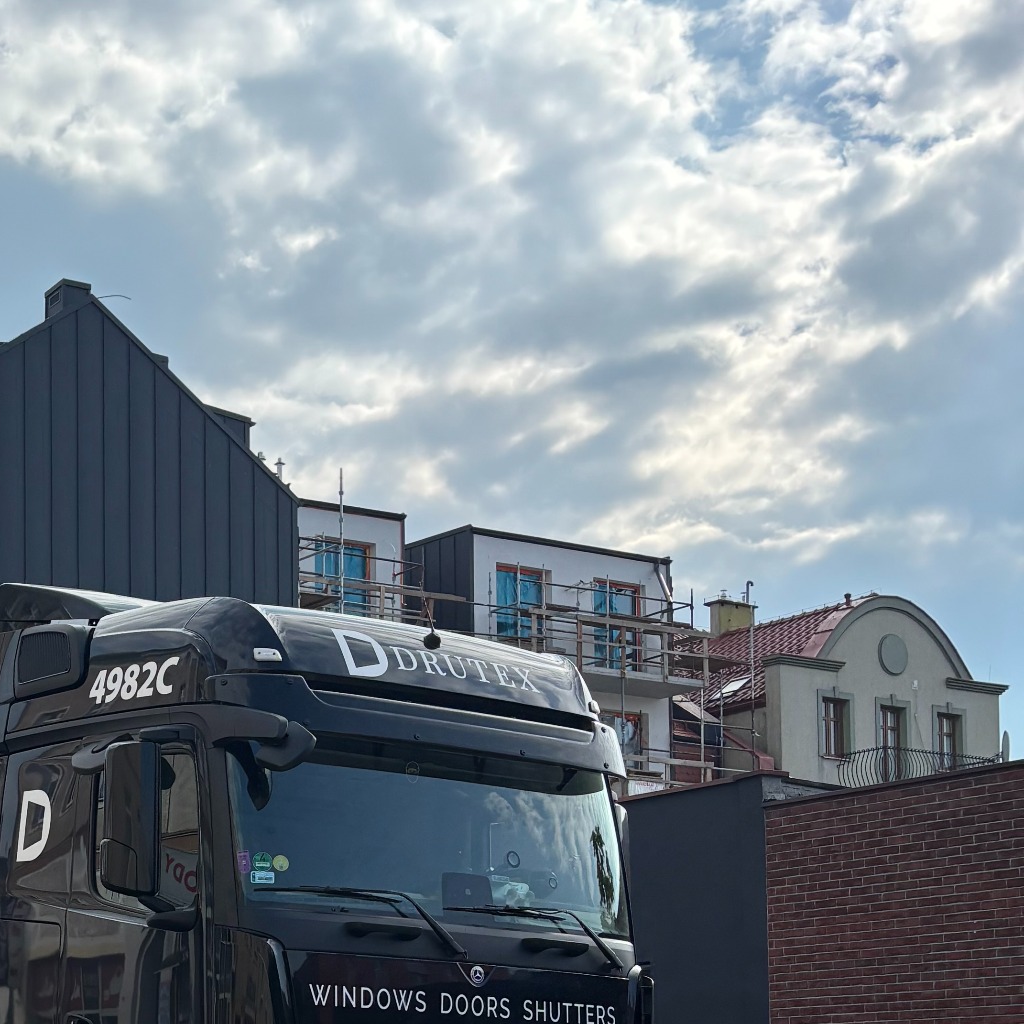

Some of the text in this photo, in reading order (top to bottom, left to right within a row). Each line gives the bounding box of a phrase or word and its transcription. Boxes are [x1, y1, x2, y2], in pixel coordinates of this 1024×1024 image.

[88, 656, 180, 705] 4982C
[388, 645, 541, 694] DRUTEX
[16, 789, 51, 862] D
[309, 983, 426, 1013] WINDOWS
[440, 992, 510, 1018] DOORS
